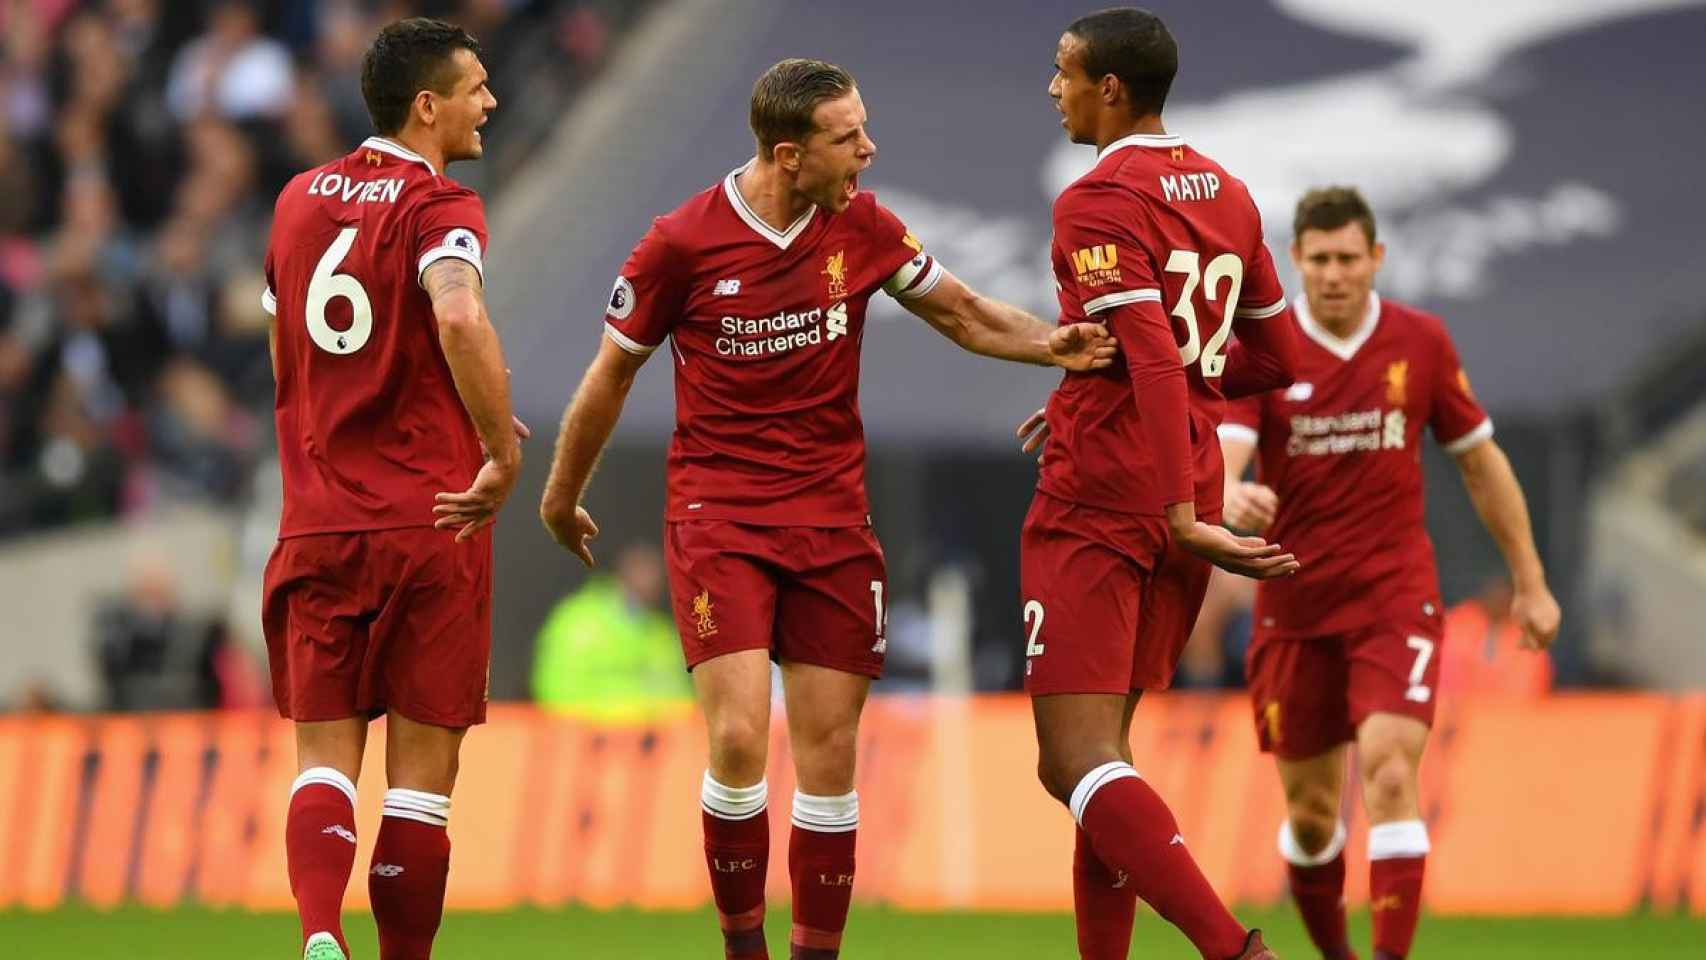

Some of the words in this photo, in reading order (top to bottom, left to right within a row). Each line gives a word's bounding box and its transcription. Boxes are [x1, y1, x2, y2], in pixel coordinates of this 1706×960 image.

[308, 172, 405, 205] LOVREN
[1159, 172, 1221, 202] MATIP
[1071, 244, 1118, 275] WU
[305, 227, 374, 355] 6
[721, 307, 822, 335] Standard
[1164, 249, 1244, 378] 32
[715, 325, 821, 356] Chartered
[1290, 408, 1382, 435] Standard
[1286, 430, 1380, 457] Chartered
[1406, 634, 1434, 686] 7
